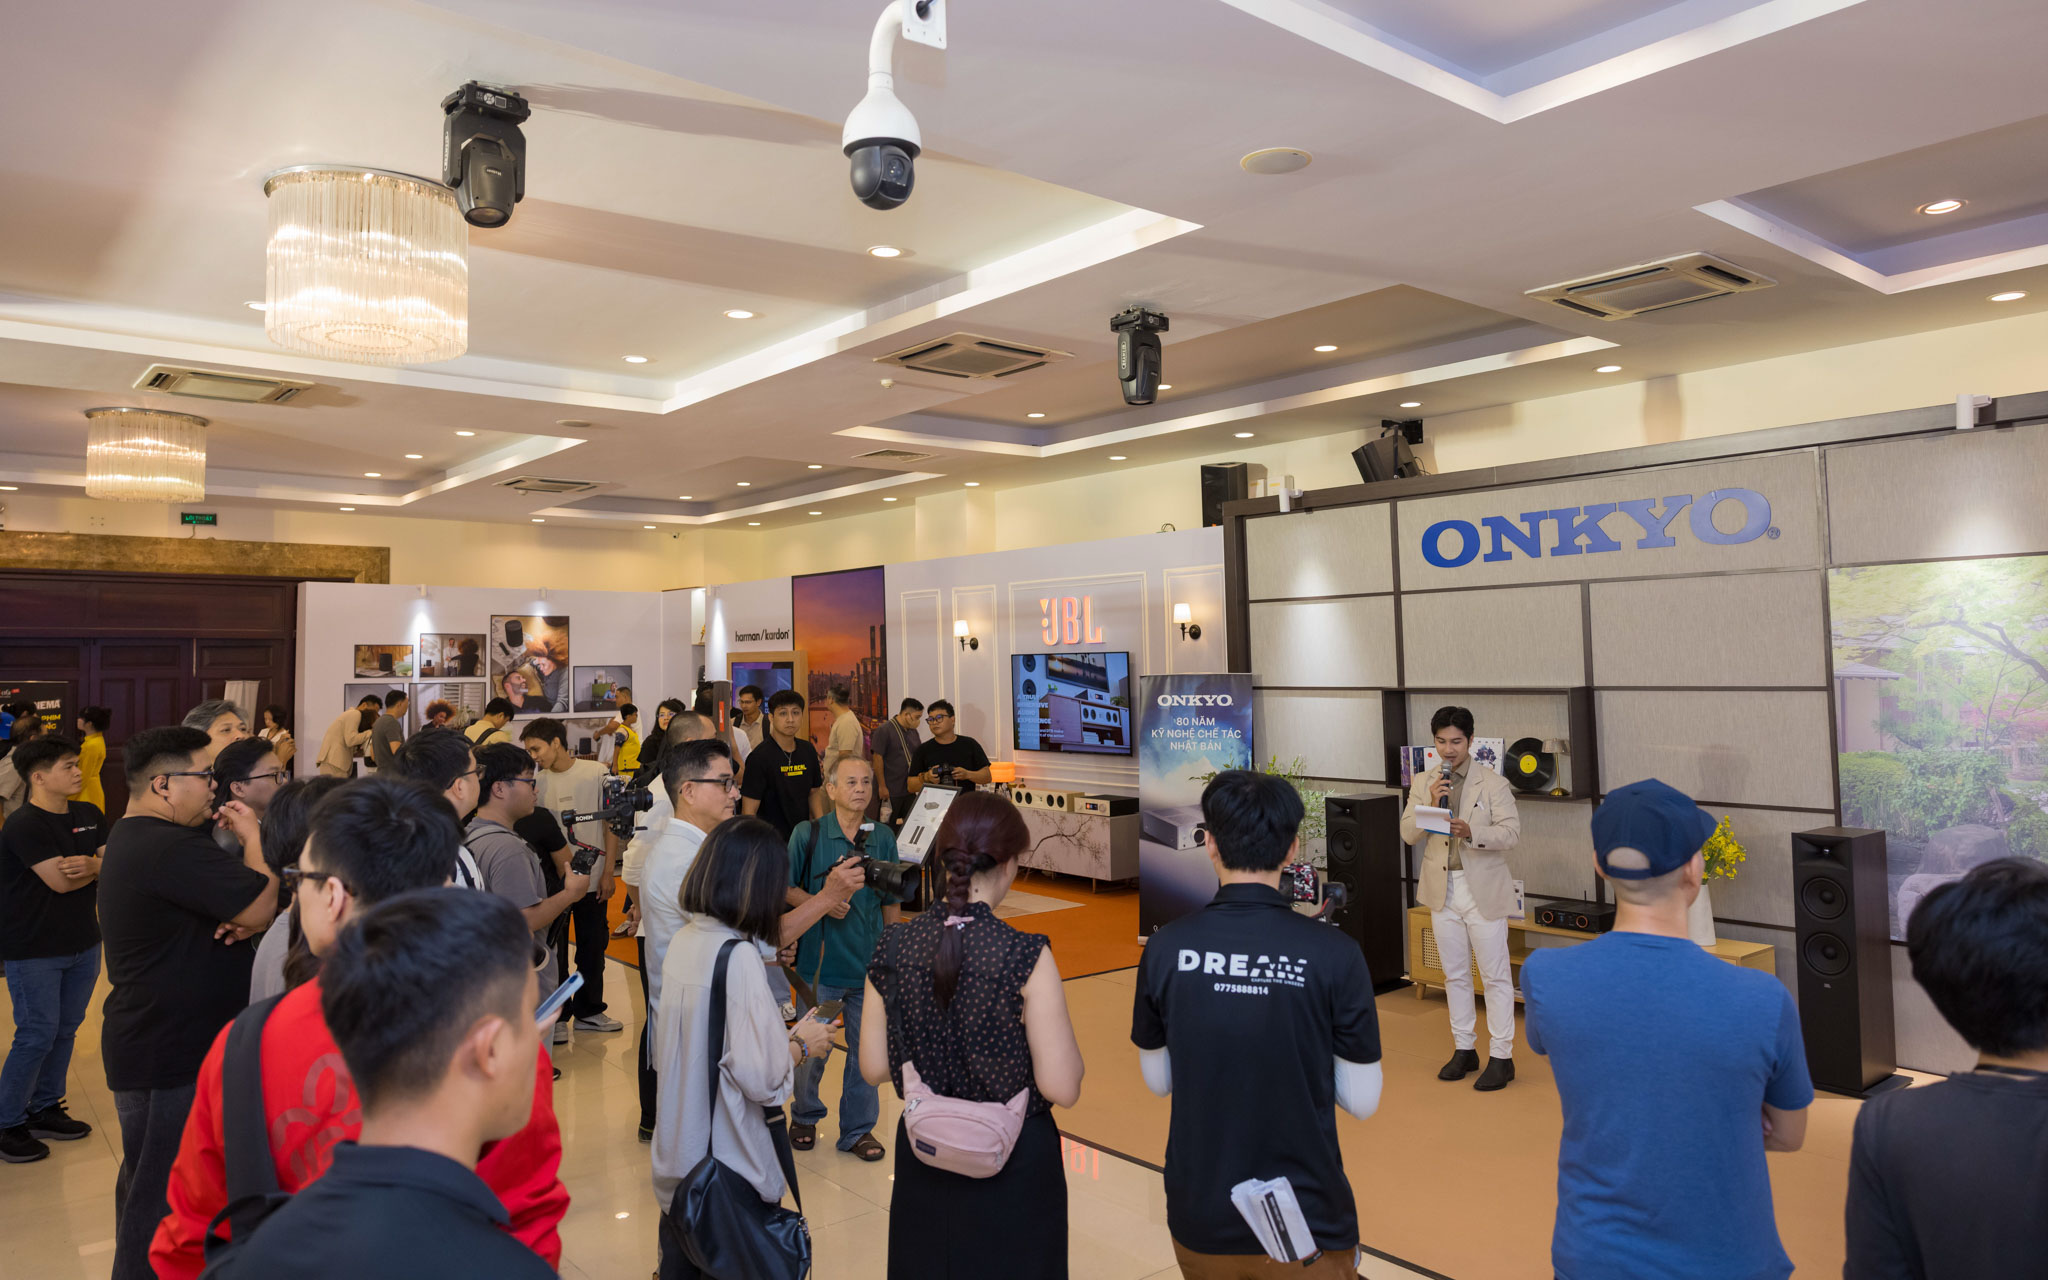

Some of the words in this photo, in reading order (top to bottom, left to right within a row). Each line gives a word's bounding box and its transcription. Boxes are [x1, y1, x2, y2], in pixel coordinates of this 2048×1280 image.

[1421, 487, 1772, 568] ONKYO
[1040, 595, 1103, 646] JBL
[34, 699, 61, 710] NEMA
[1157, 694, 1233, 707] ONKYO
[1176, 717, 1189, 726] 80
[1191, 715, 1215, 726] NĂM
[1221, 728, 1242, 739] TÁC
[1170, 741, 1197, 753] NHẬT
[1178, 949, 1308, 983] DREAM
[1269, 963, 1304, 974] VIEW
[1213, 982, 1269, 996] 0775888814
